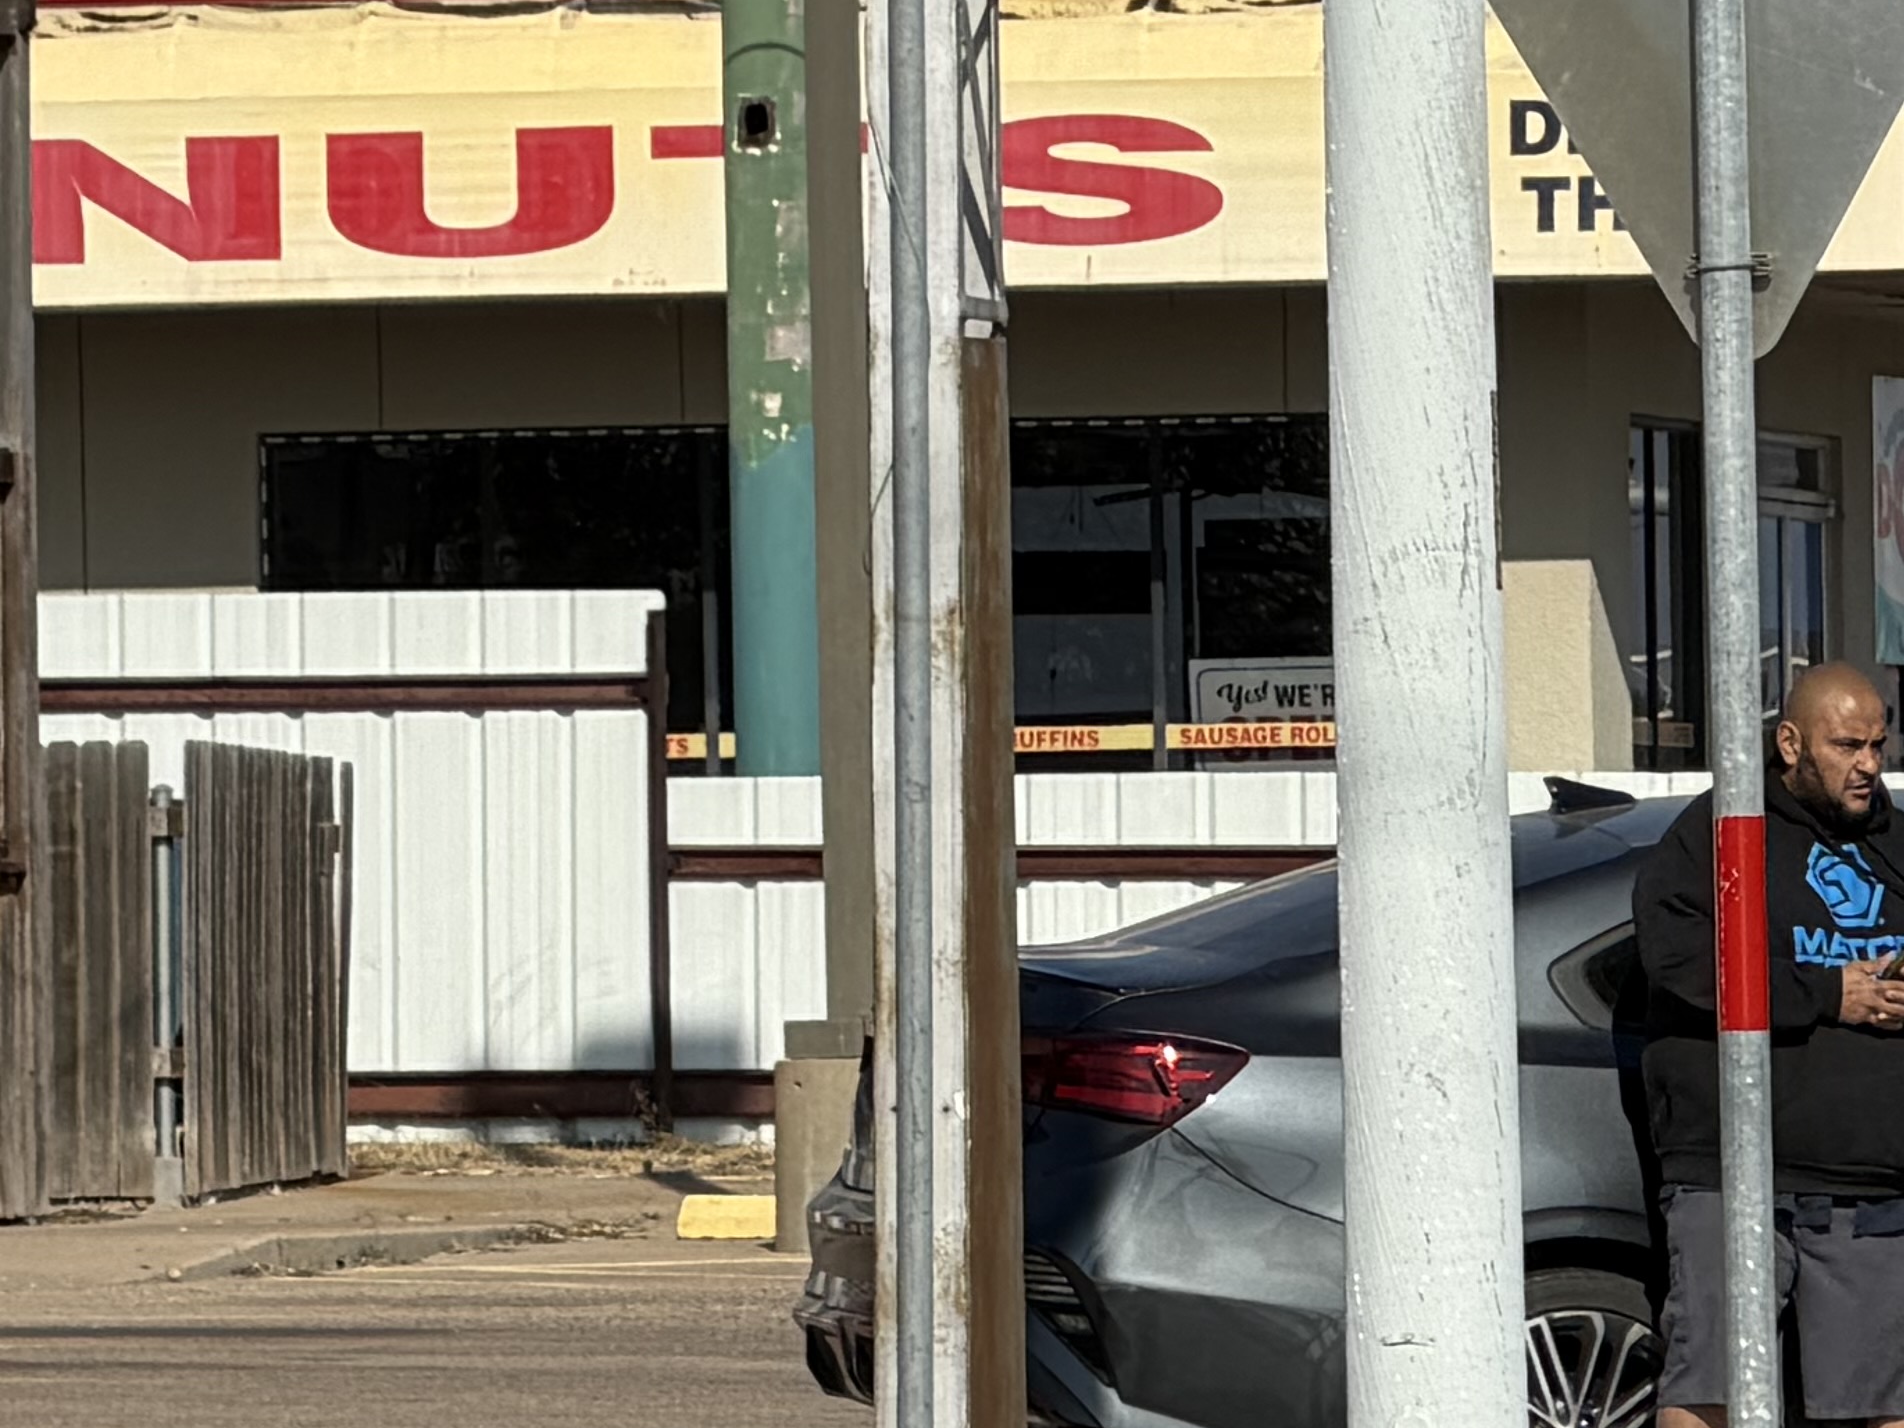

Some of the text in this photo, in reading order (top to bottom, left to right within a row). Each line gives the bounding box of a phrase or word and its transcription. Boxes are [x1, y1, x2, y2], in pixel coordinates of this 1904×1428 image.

[1510, 100, 1578, 156] D
[33, 113, 1222, 265] NUS
[1216, 680, 1335, 712] Yes! WE'R
[1013, 730, 1100, 749] UFFINS
[1179, 726, 1335, 745] SAUSAGE ROL
